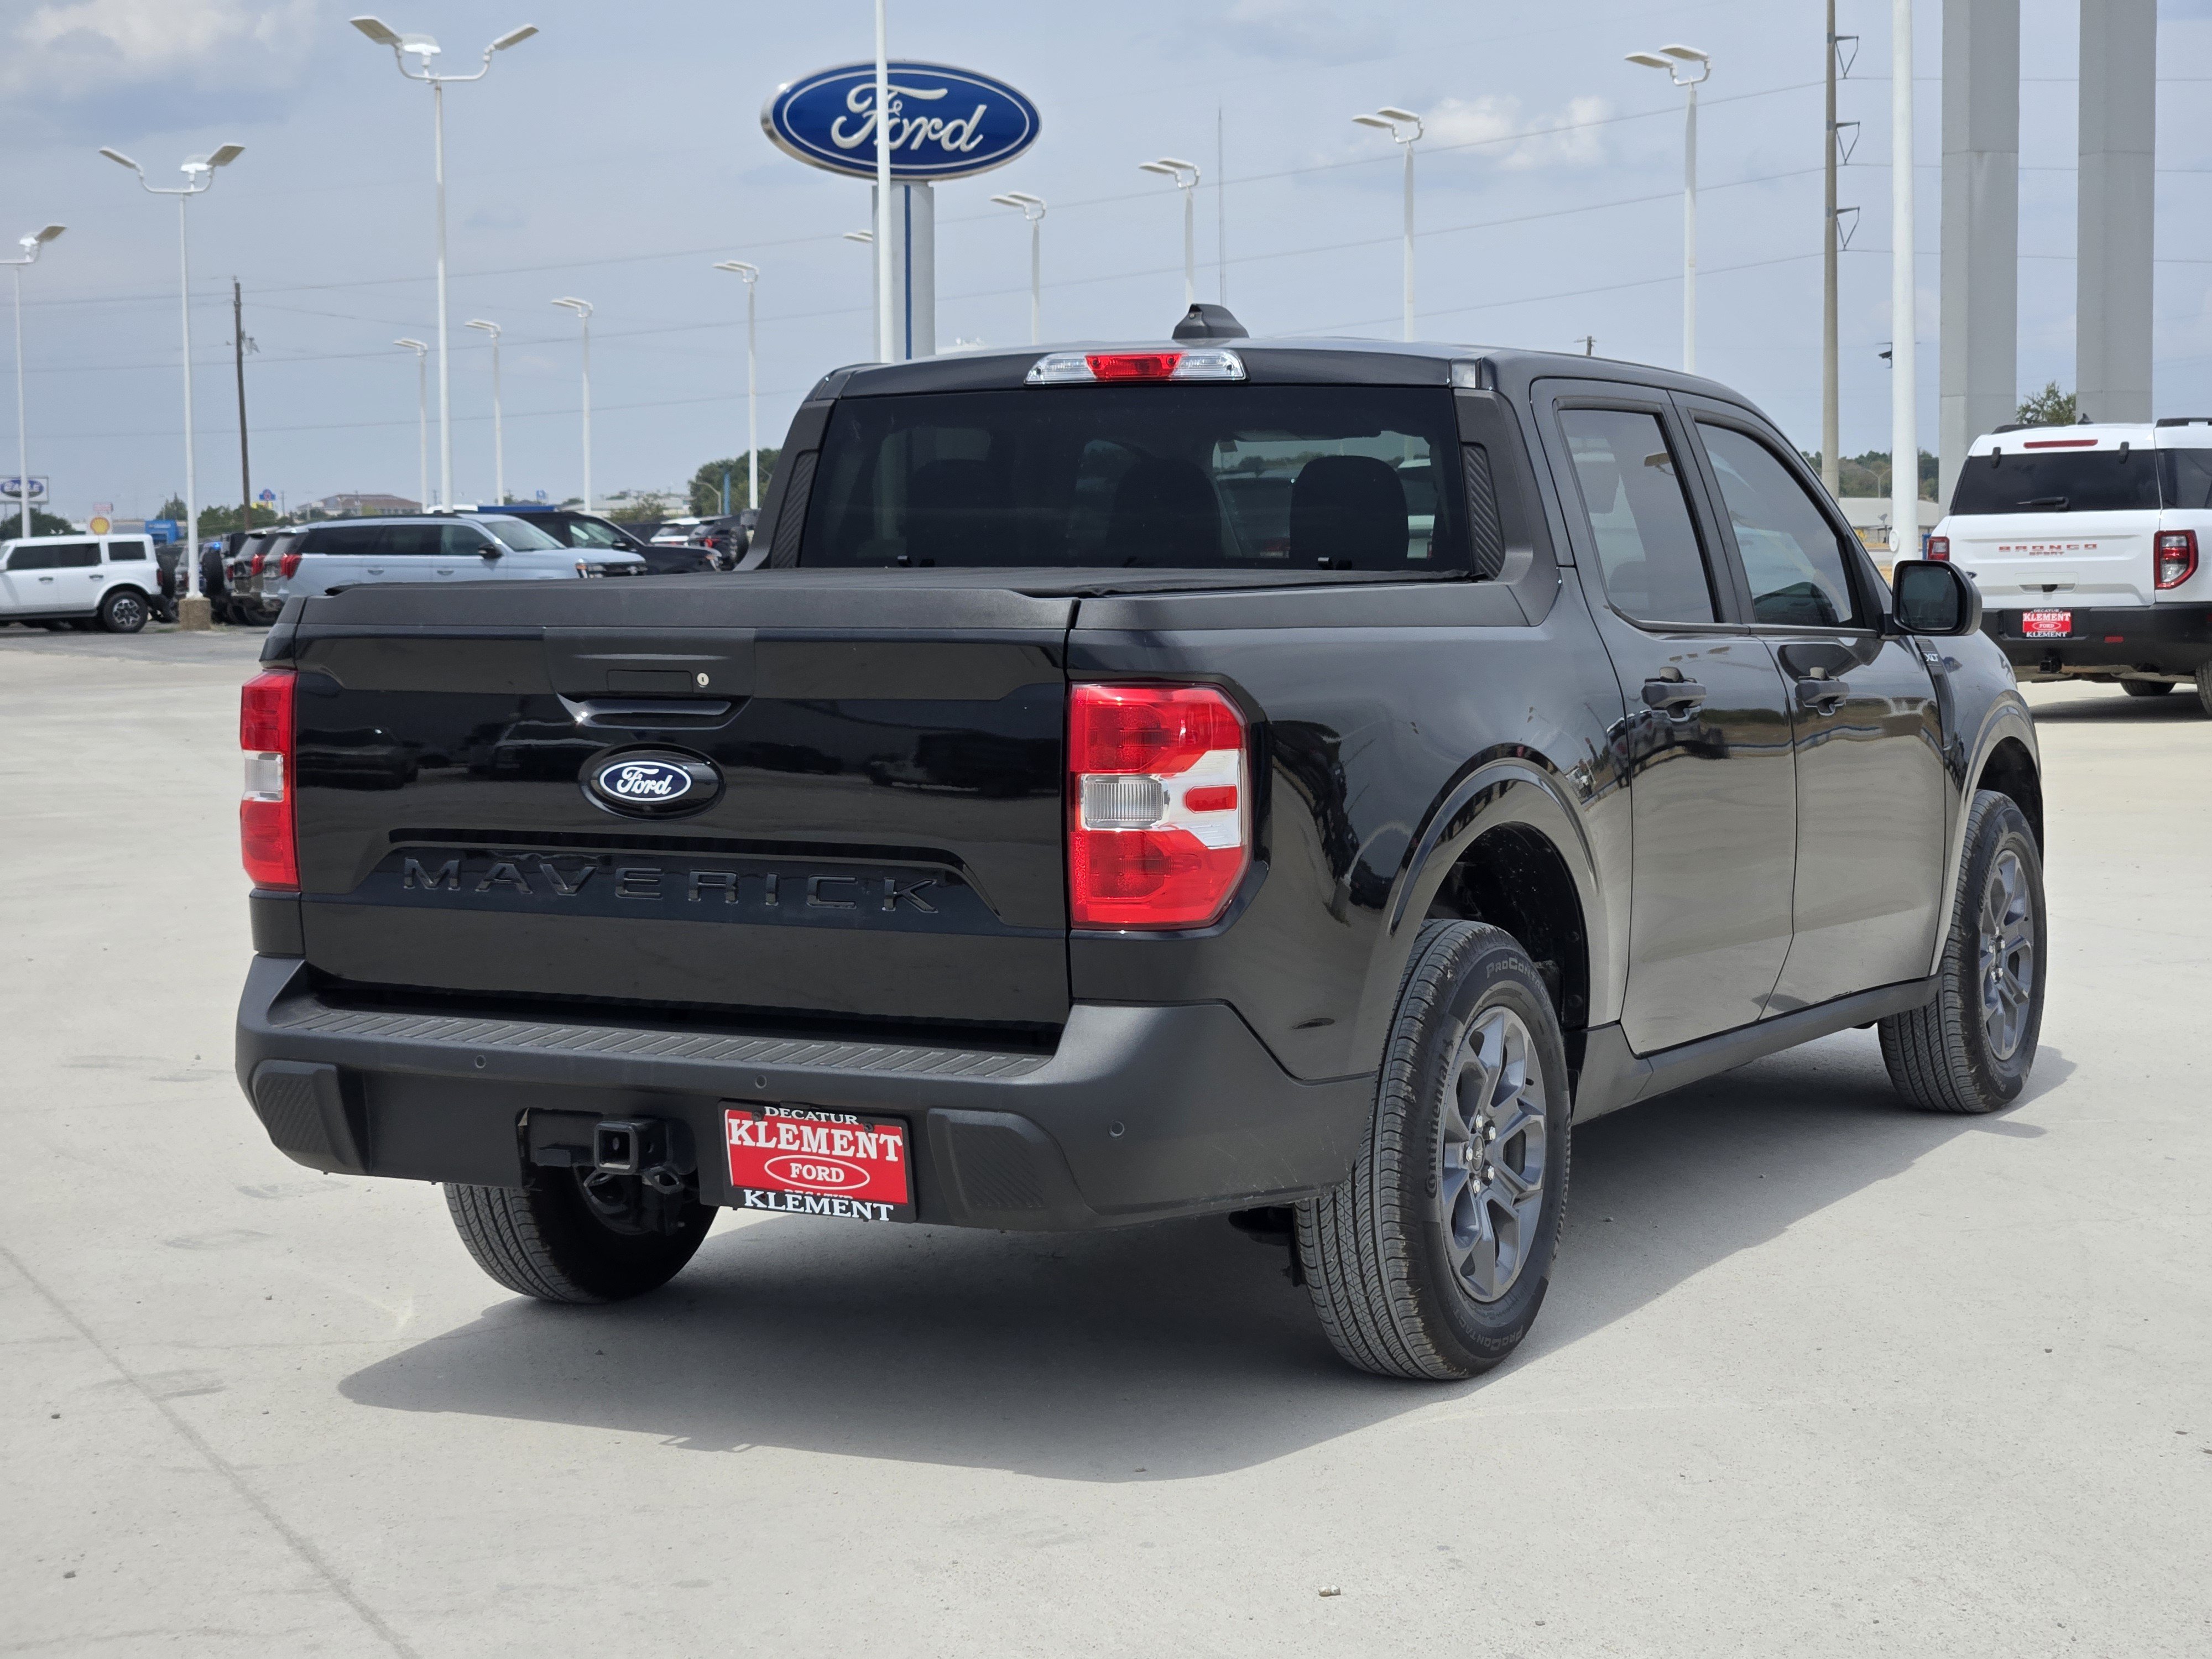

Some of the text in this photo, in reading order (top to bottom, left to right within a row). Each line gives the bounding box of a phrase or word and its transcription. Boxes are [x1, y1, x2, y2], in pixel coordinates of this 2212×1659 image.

[831, 82, 987, 153] Ford
[4, 482, 39, 492] EALE
[1999, 544, 2098, 552] BRONCO
[2023, 612, 2071, 622] KLEMENT
[1924, 653, 1939, 662] XLT
[617, 766, 674, 795] Ford
[403, 857, 938, 914] MAVERICK
[764, 1106, 859, 1125] DECATUR
[728, 1118, 903, 1161] KLEMENT
[790, 1162, 845, 1183] FORD
[743, 1189, 894, 1221] KLEMENT
